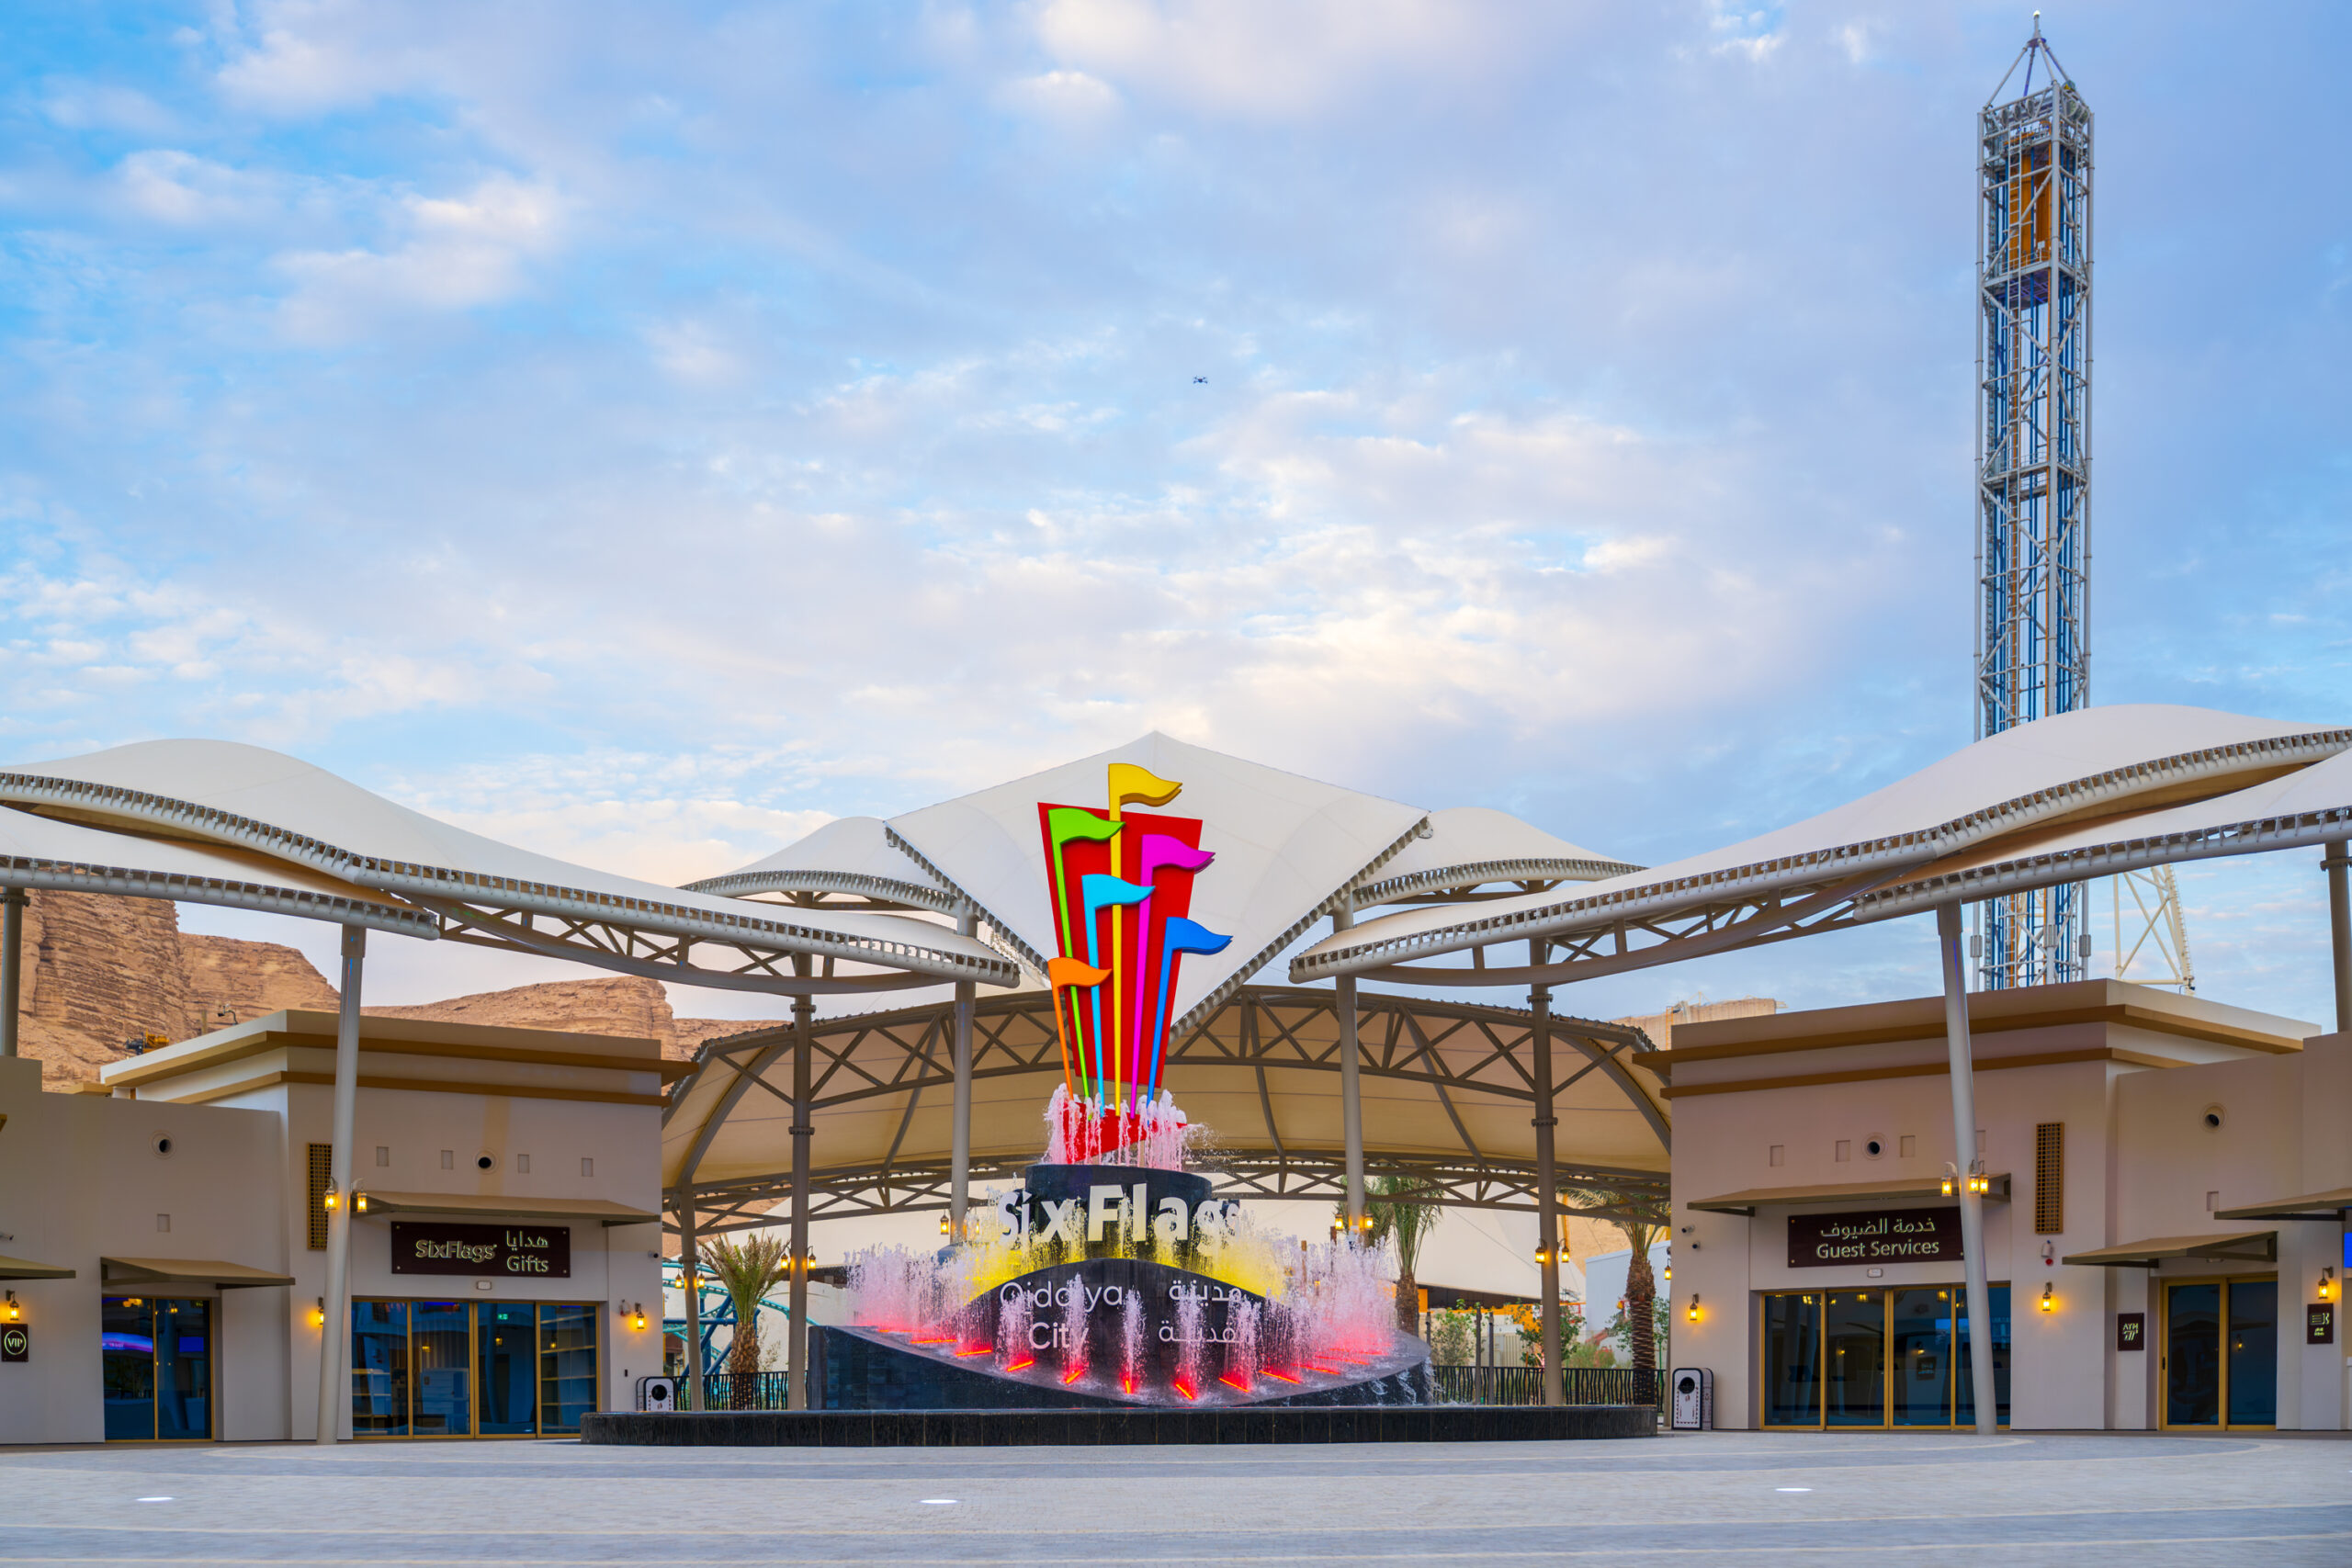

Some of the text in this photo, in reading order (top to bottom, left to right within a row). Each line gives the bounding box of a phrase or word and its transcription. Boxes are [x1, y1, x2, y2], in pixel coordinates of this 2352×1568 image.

[1820, 1217, 1937, 1240] خدمة الضيوف
[415, 1239, 497, 1263] SixFlags
[506, 1230, 549, 1251] هدايا
[1815, 1238, 1939, 1259] Guest Services
[506, 1254, 549, 1272] Gifts
[1000, 1280, 1124, 1313] Qidya
[7, 1337, 23, 1348] VIP
